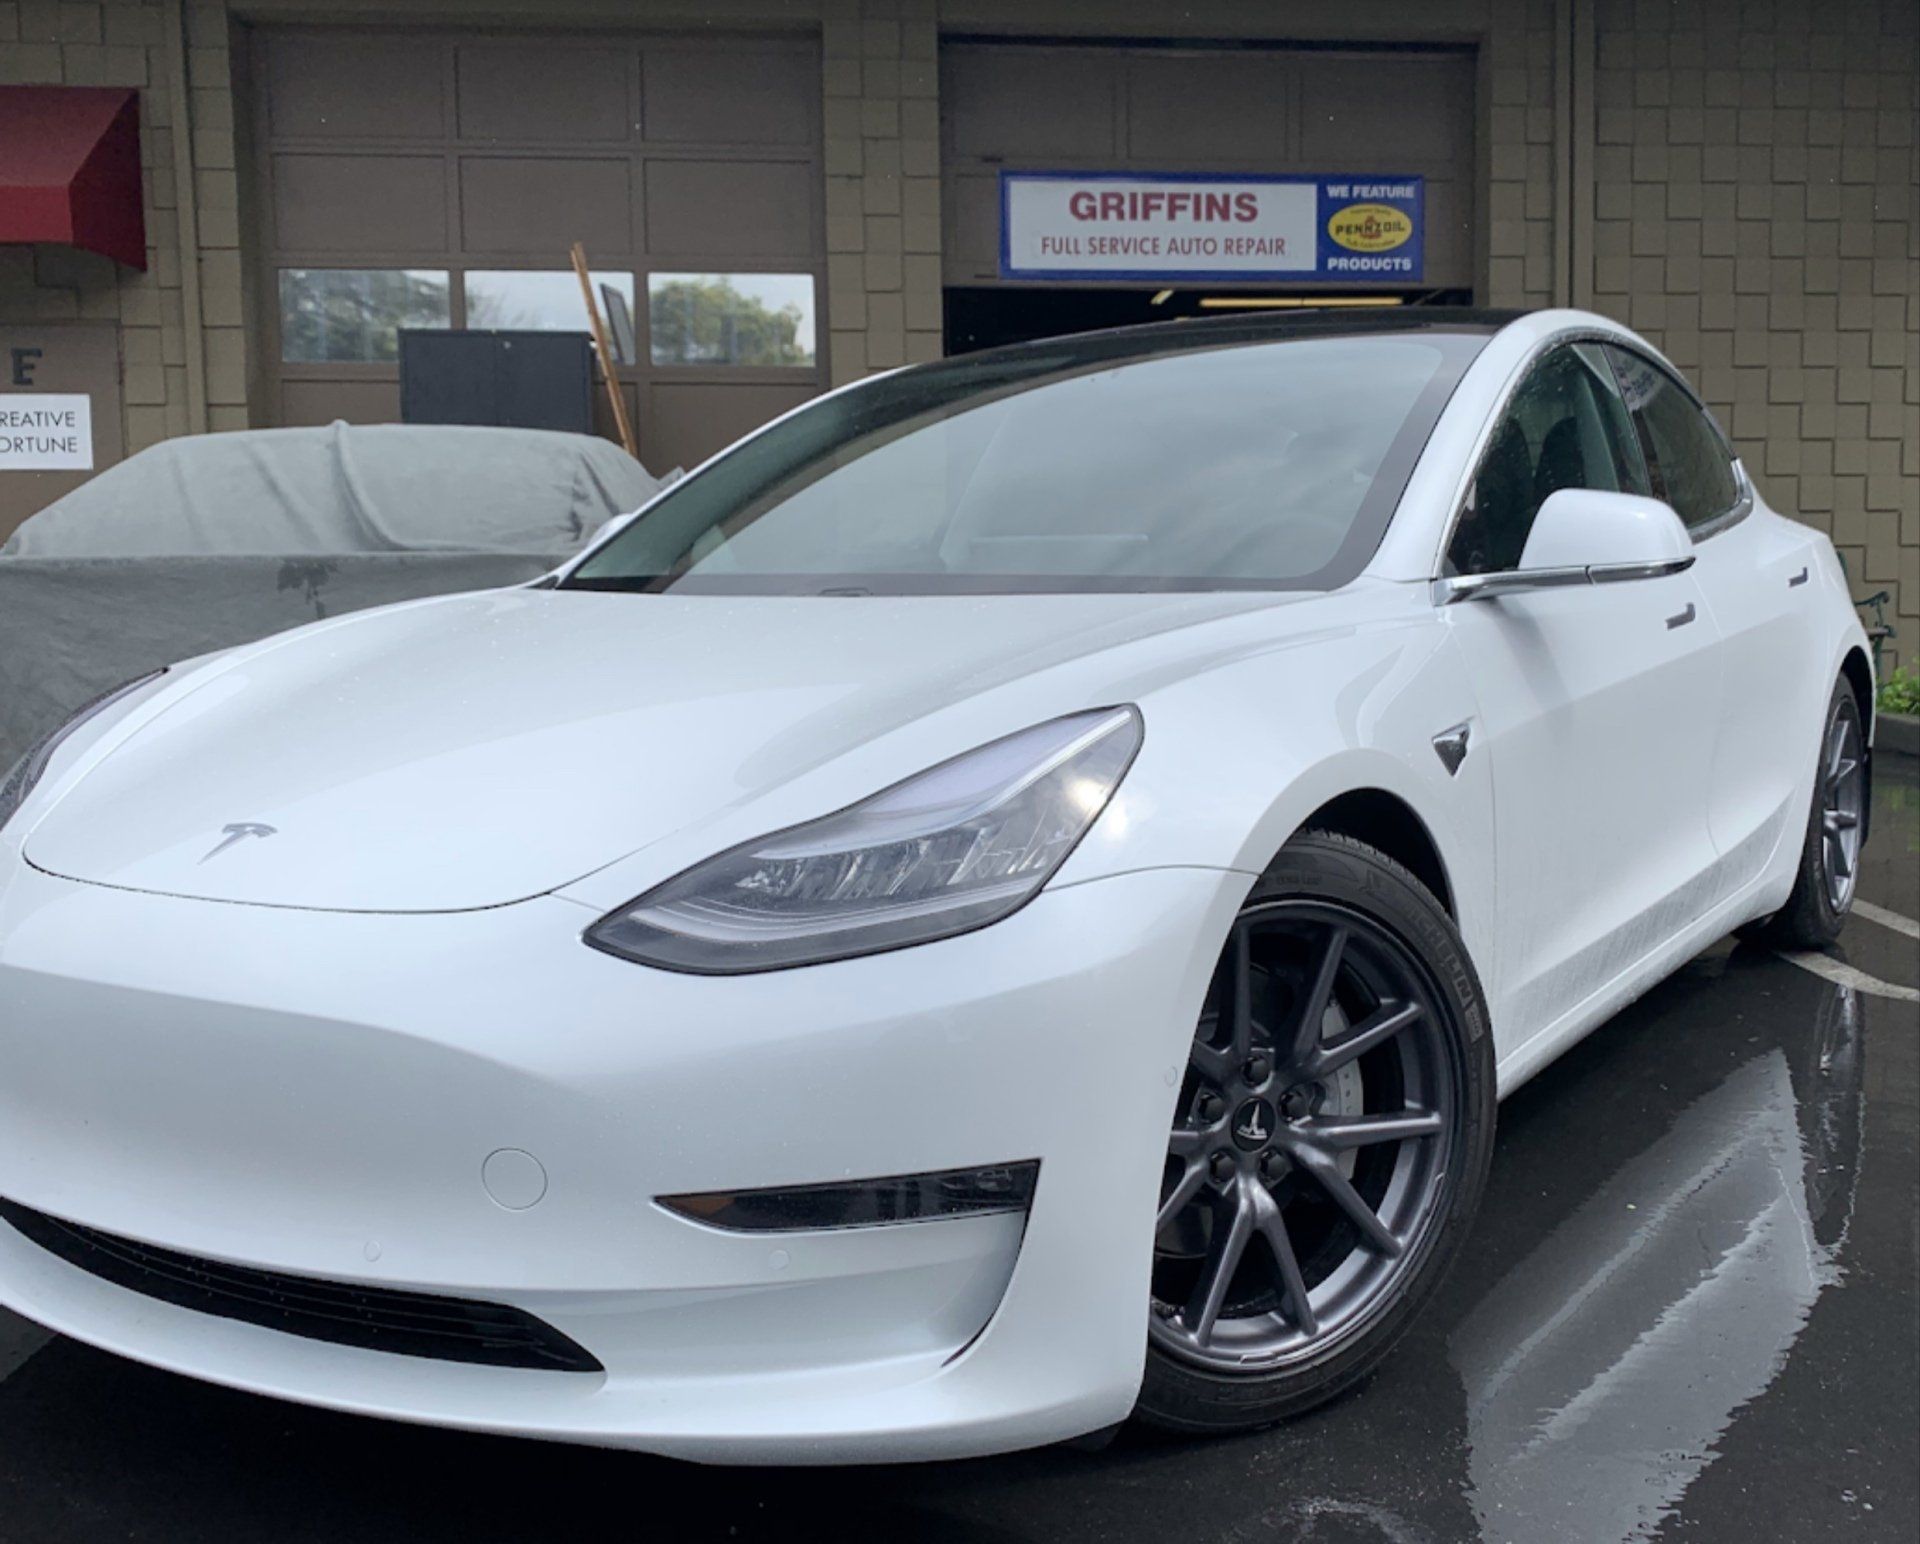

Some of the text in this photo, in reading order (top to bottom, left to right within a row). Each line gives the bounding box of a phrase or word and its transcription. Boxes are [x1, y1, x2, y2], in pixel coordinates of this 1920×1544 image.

[1327, 184, 1415, 199] WE FEATURE
[1069, 191, 1258, 222] GRIFFINS
[1335, 221, 1405, 236] PENNZOIL
[1041, 236, 1286, 256] FULL SERVICE AUTO REPAIR
[1327, 257, 1412, 271] PRODUCTS
[11, 348, 42, 385] E
[1398, 897, 1474, 1009] ICHELIN
